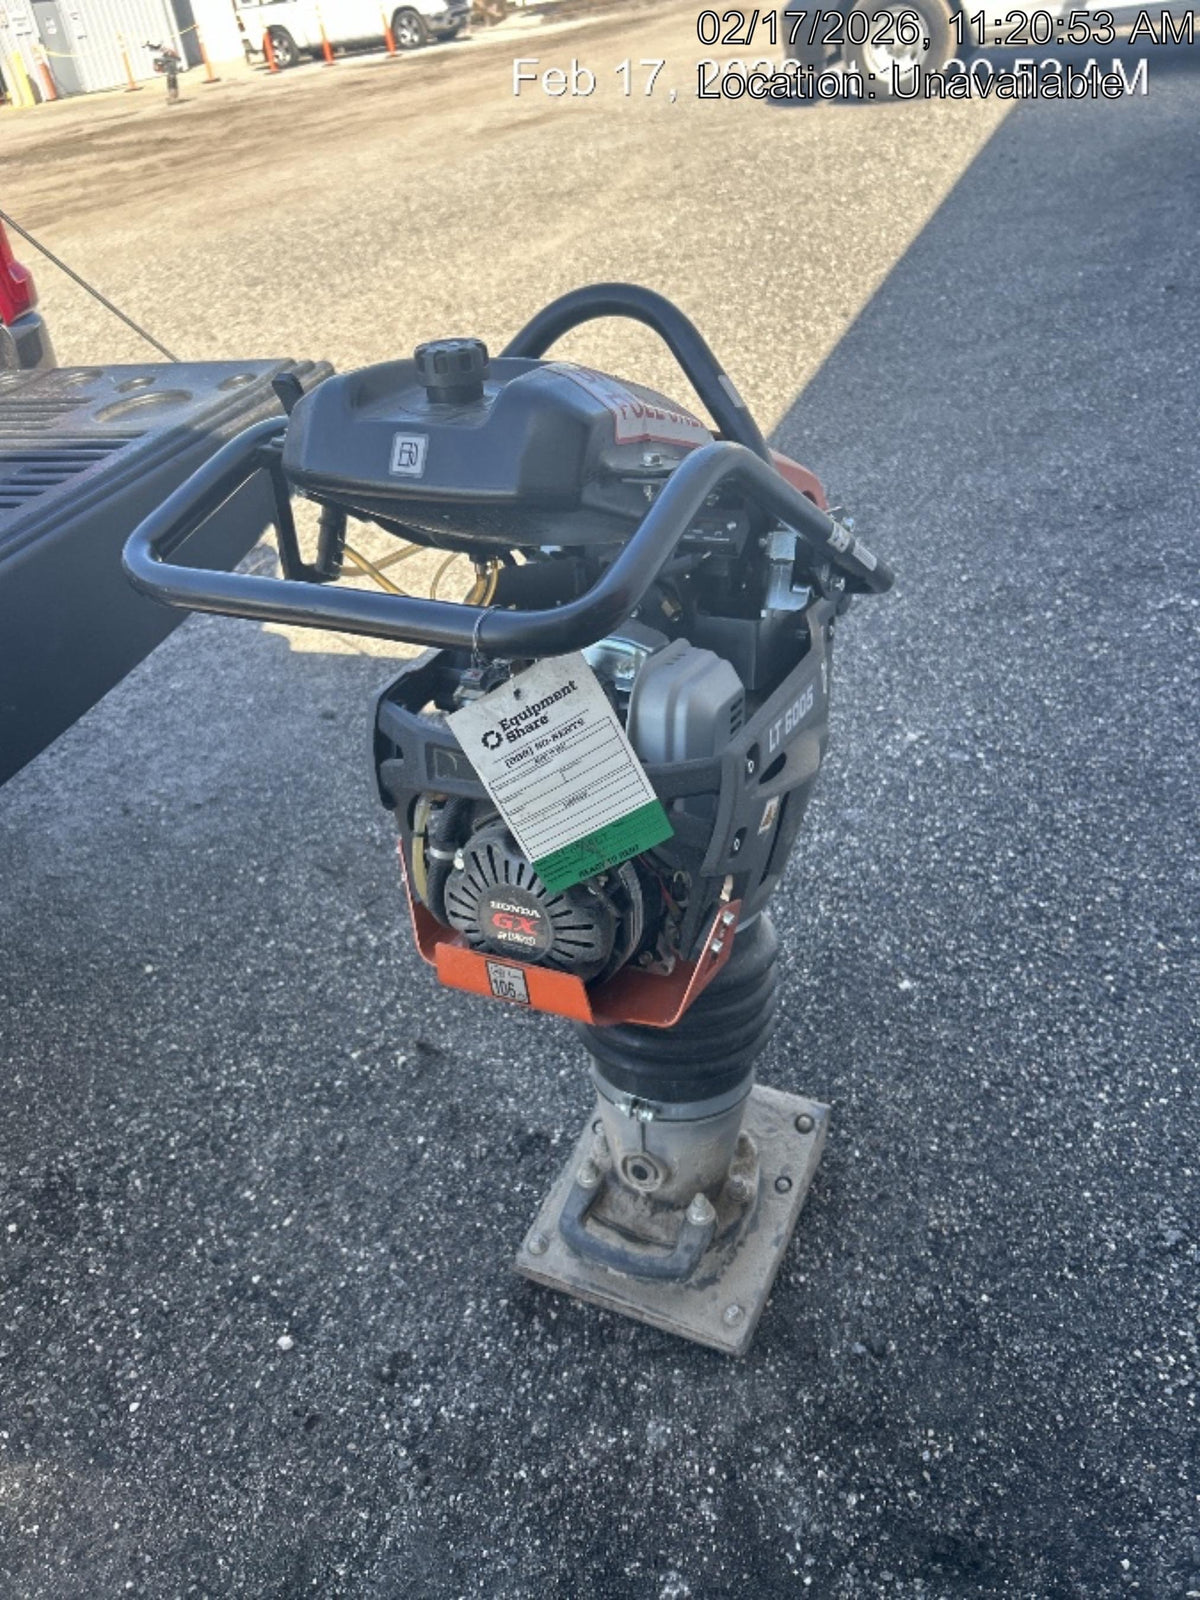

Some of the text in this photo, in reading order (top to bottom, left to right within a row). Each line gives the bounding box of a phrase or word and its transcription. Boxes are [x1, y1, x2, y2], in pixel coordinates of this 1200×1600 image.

[499, 680, 578, 732] Equipment
[769, 683, 814, 752] LT 6005
[506, 715, 549, 743] Share
[489, 900, 541, 918] HONDA
[491, 911, 539, 936] GX
